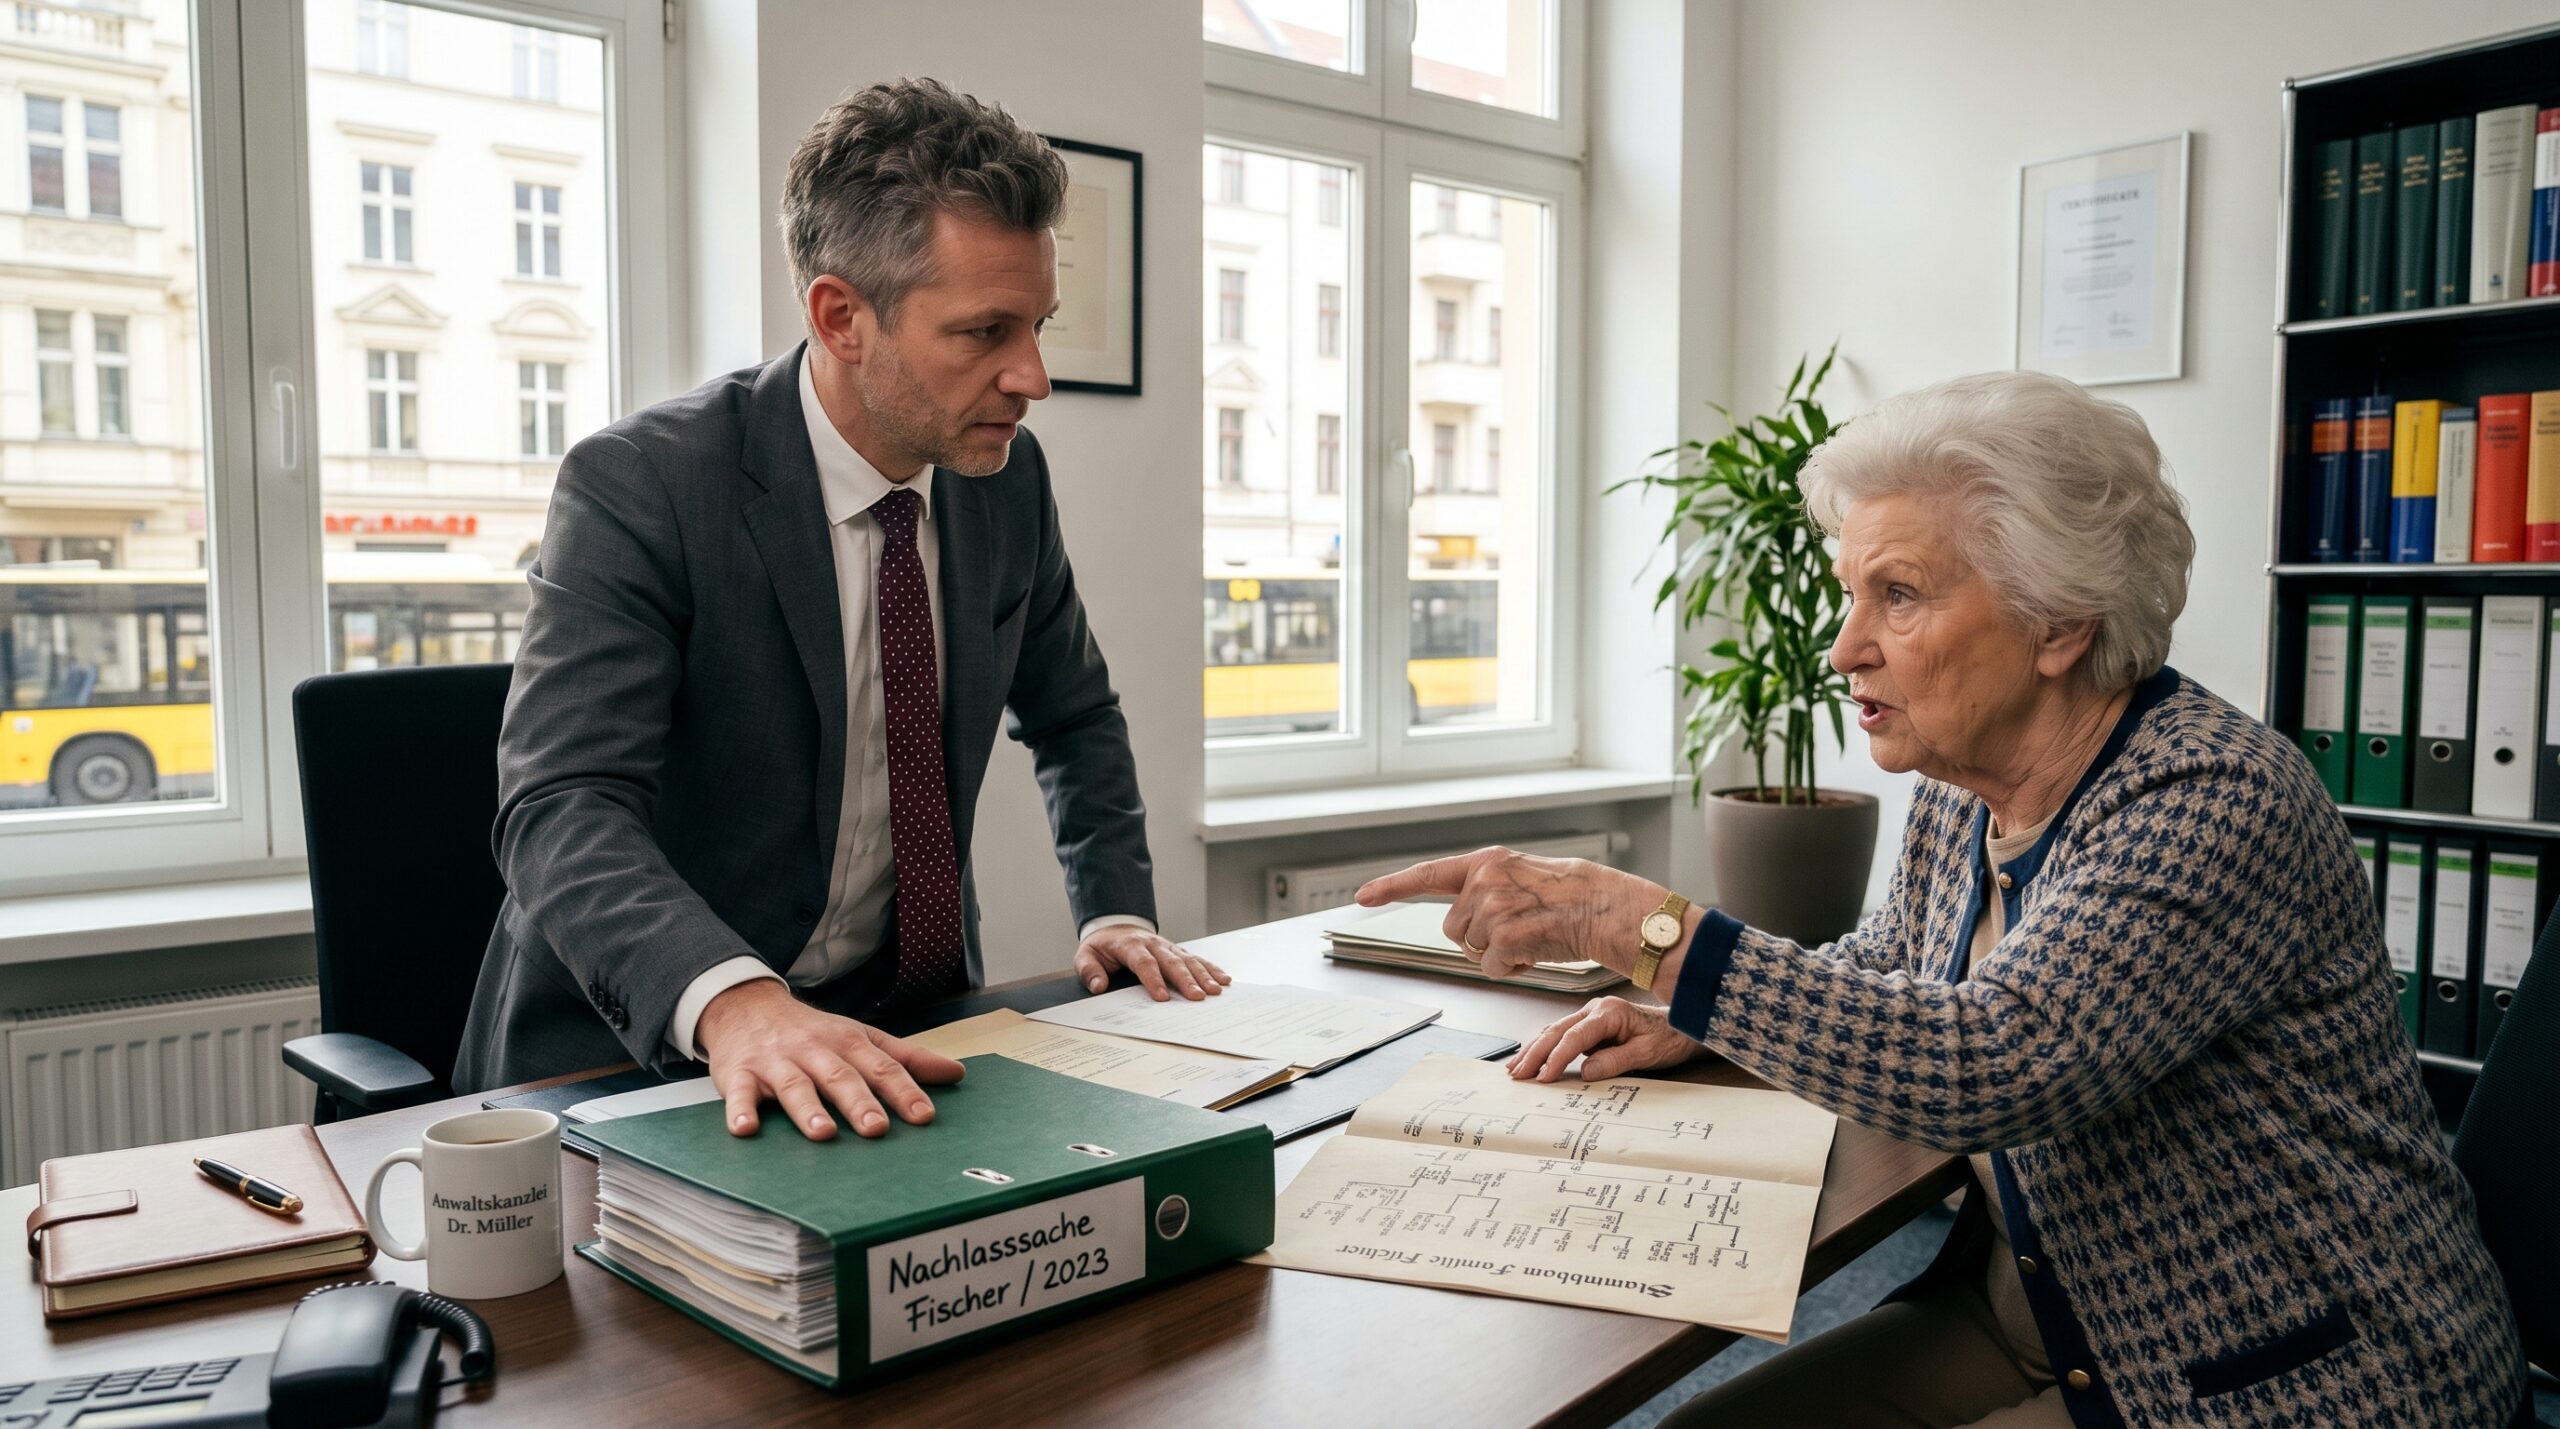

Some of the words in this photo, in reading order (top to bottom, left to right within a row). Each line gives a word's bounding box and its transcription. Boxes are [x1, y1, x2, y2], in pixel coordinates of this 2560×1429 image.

[432, 1184, 547, 1212] Anwaltskanzlei
[448, 1217, 472, 1235] Dr.
[476, 1215, 534, 1235] Müller
[889, 1211, 1095, 1295] Nachlasssache
[904, 1282, 1012, 1333] Fischer
[1020, 1259, 1035, 1308] /
[1043, 1247, 1110, 1291] 2023
